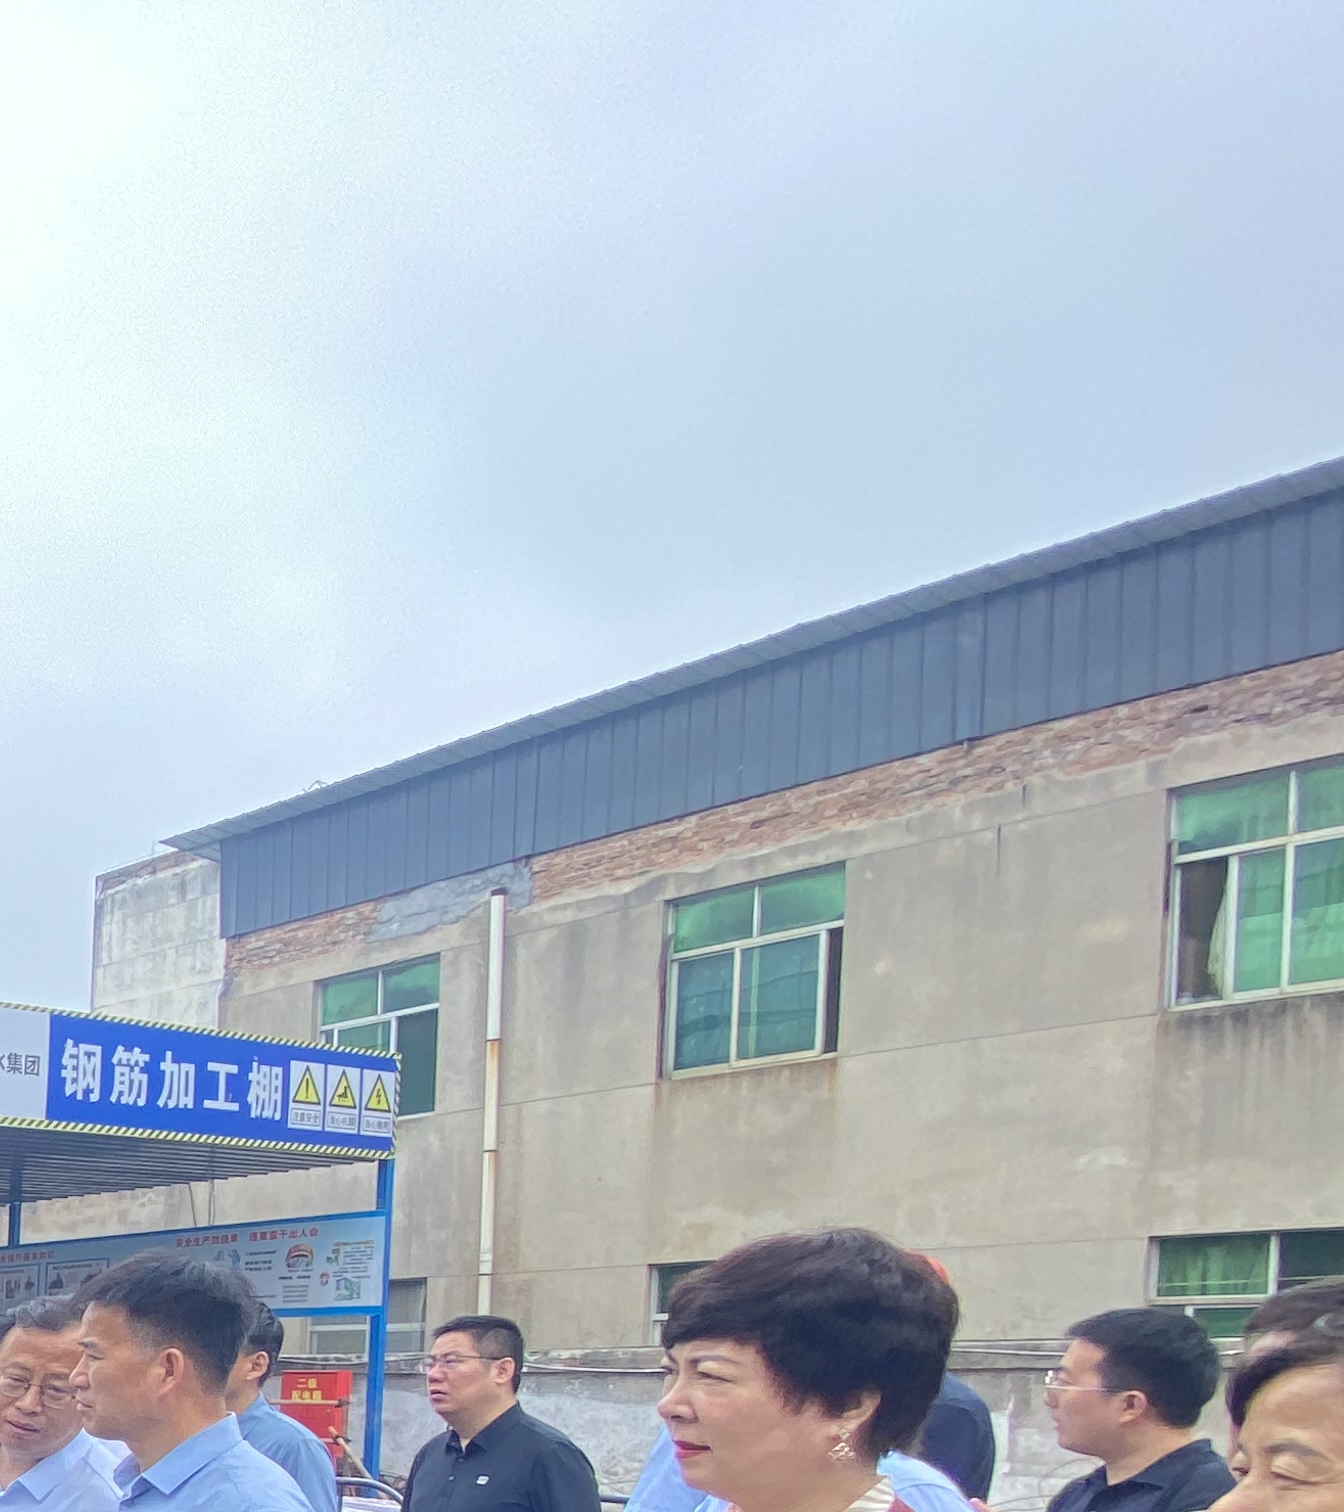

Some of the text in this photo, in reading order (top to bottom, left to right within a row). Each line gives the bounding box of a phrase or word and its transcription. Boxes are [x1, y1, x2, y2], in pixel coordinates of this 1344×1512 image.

[60, 1037, 284, 1121] 钢筋加工棚
